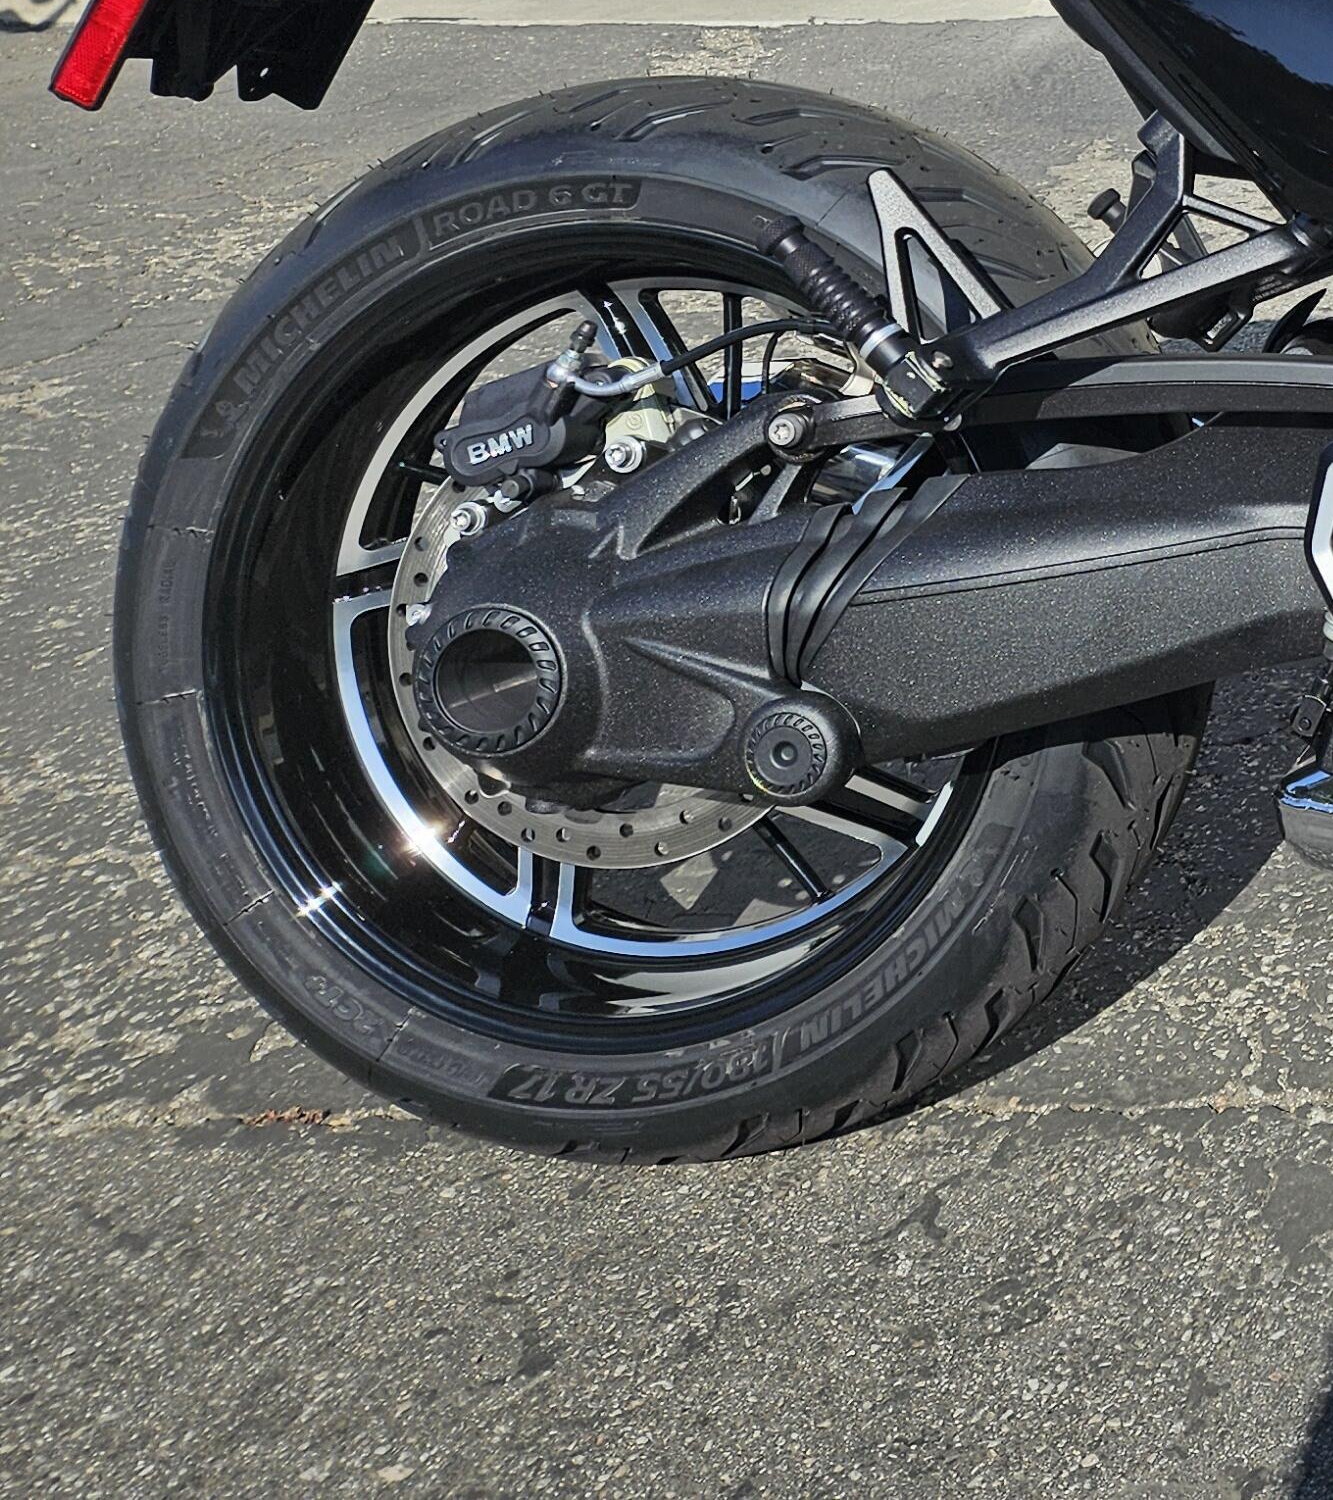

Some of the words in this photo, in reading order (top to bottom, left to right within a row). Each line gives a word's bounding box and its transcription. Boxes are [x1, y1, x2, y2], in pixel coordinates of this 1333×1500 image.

[233, 240, 405, 394] MICHELIN
[433, 188, 536, 238] ROAD
[548, 188, 573, 207] 6
[581, 182, 635, 204] GT
[466, 423, 535, 465] BMW
[799, 888, 966, 1051] MICHELIN
[507, 1069, 559, 1101] 17
[566, 1074, 624, 1106] ZR
